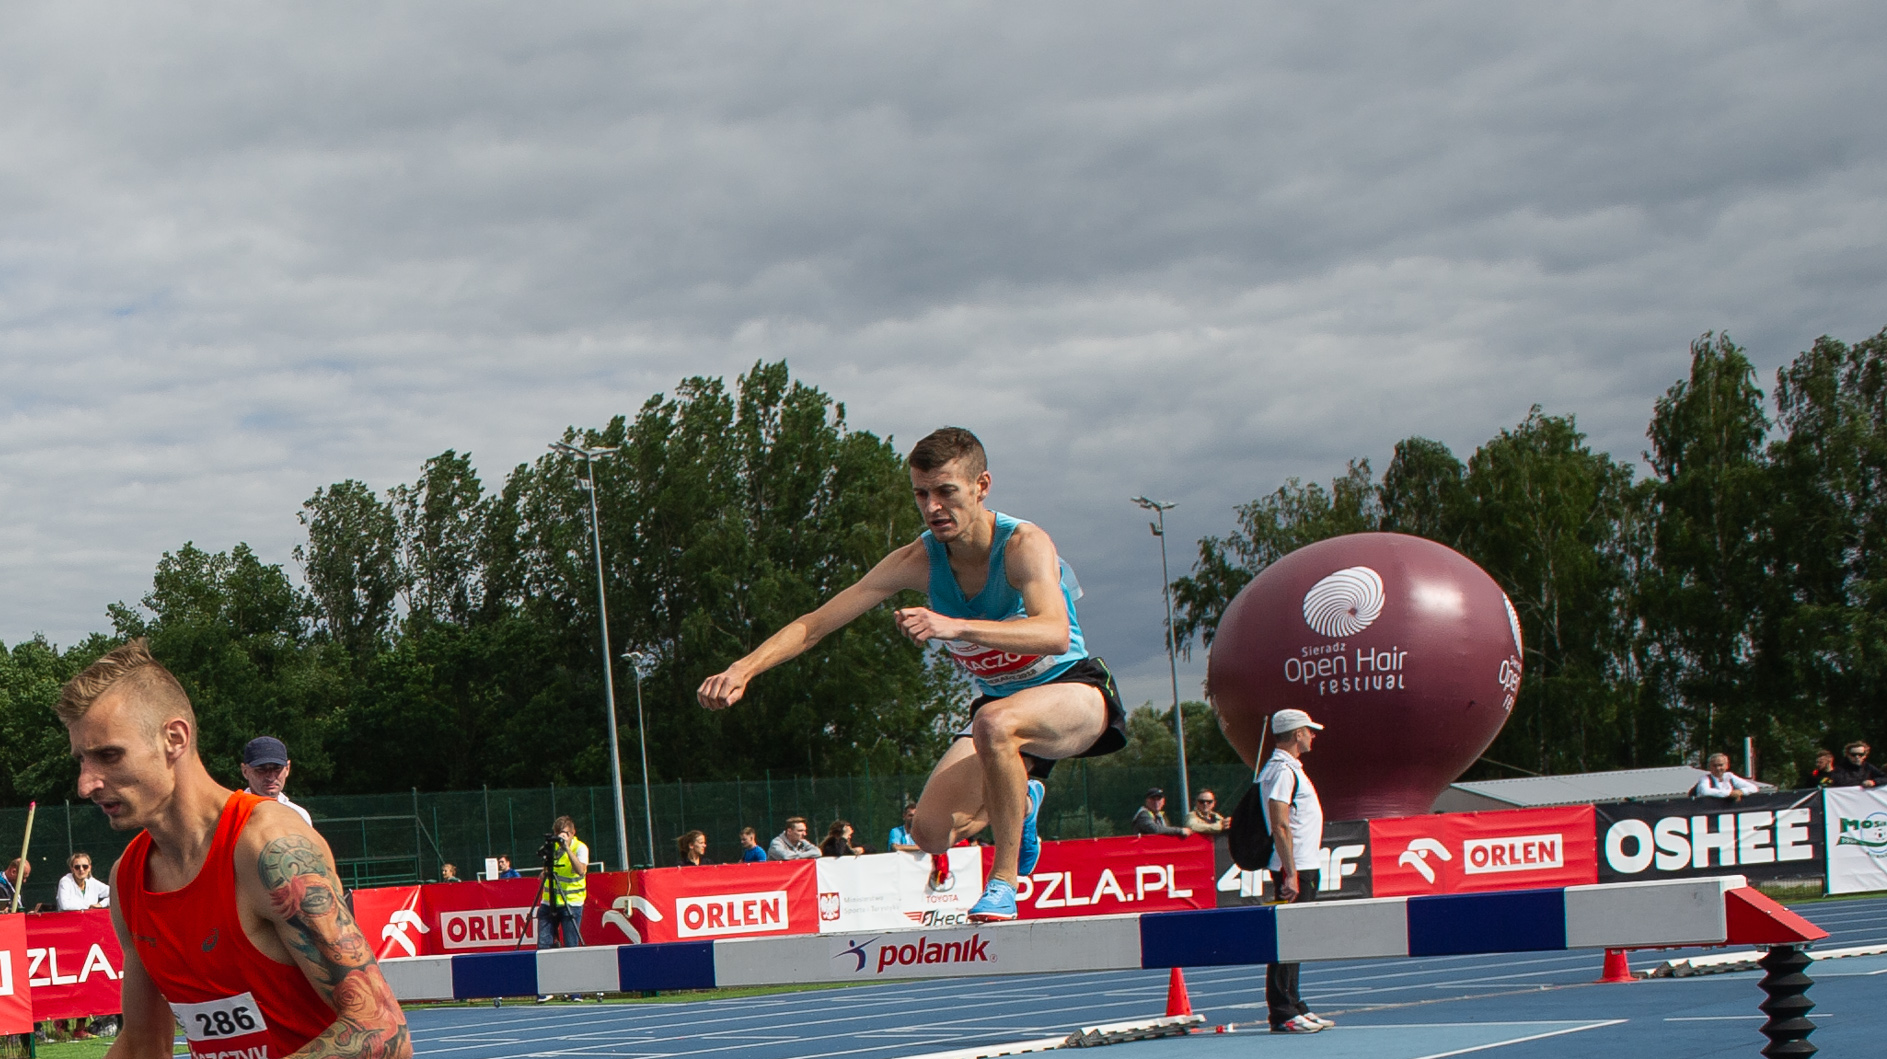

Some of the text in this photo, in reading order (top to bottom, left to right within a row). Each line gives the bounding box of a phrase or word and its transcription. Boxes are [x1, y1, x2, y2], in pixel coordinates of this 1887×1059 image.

[1284, 646, 1408, 685] Open Hair
[1301, 642, 1347, 658] Sieradz
[1469, 838, 1556, 870] ORLEN
[1605, 807, 1814, 874] OSHEE
[683, 896, 781, 935] ORLEN
[926, 894, 959, 904] TOYOTA
[446, 913, 534, 943] ORLEN
[26, 943, 124, 988] ZLA.
[877, 933, 991, 974] polanik
[195, 1005, 255, 1037] 286
